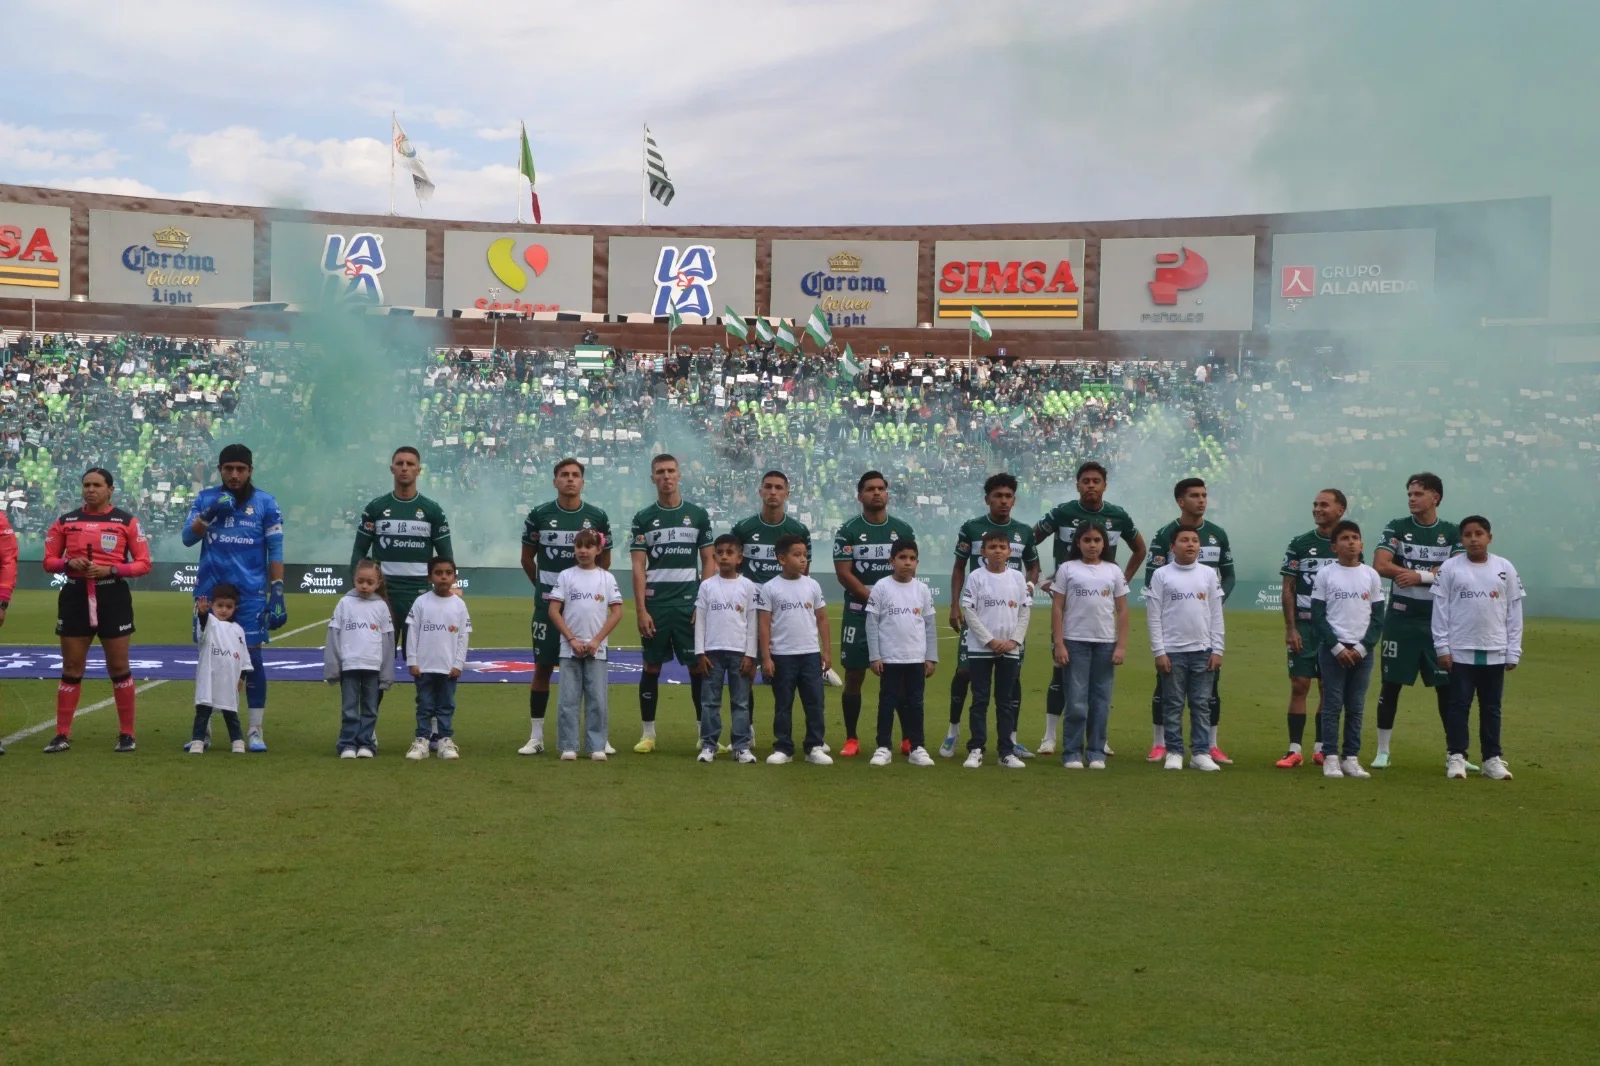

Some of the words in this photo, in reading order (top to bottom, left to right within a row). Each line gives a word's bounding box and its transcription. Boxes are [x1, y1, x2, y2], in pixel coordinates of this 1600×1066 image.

[121, 244, 217, 274] Corona
[656, 246, 716, 284] LA
[940, 261, 1078, 294] SIMSA
[1322, 265, 1381, 278] GRUPO
[146, 269, 200, 287] Golden
[801, 270, 887, 298] Corona
[1320, 280, 1419, 295] ALAMEDA
[152, 287, 193, 305] Light
[653, 283, 712, 318] LA
[821, 295, 872, 312] Golden
[827, 312, 866, 328] Light
[220, 534, 254, 545] Soriana
[393, 538, 426, 549] Soriana
[762, 563, 783, 571] Soria
[871, 563, 894, 571] Soria
[301, 573, 344, 588] Santos
[571, 592, 593, 601] BBVA
[1075, 589, 1099, 597] BBVA
[1171, 592, 1195, 601] BBVA
[1333, 592, 1359, 600] BBVA
[1460, 590, 1487, 599] BBVA
[711, 603, 733, 611] BBVA
[781, 601, 803, 611] BBVA
[984, 599, 1006, 607] BBVA
[888, 607, 911, 616] BBVA
[345, 622, 368, 631] BBVA
[423, 624, 446, 632] BBVA
[532, 622, 547, 640] 23
[843, 626, 856, 644] 19
[1382, 640, 1398, 658] 29
